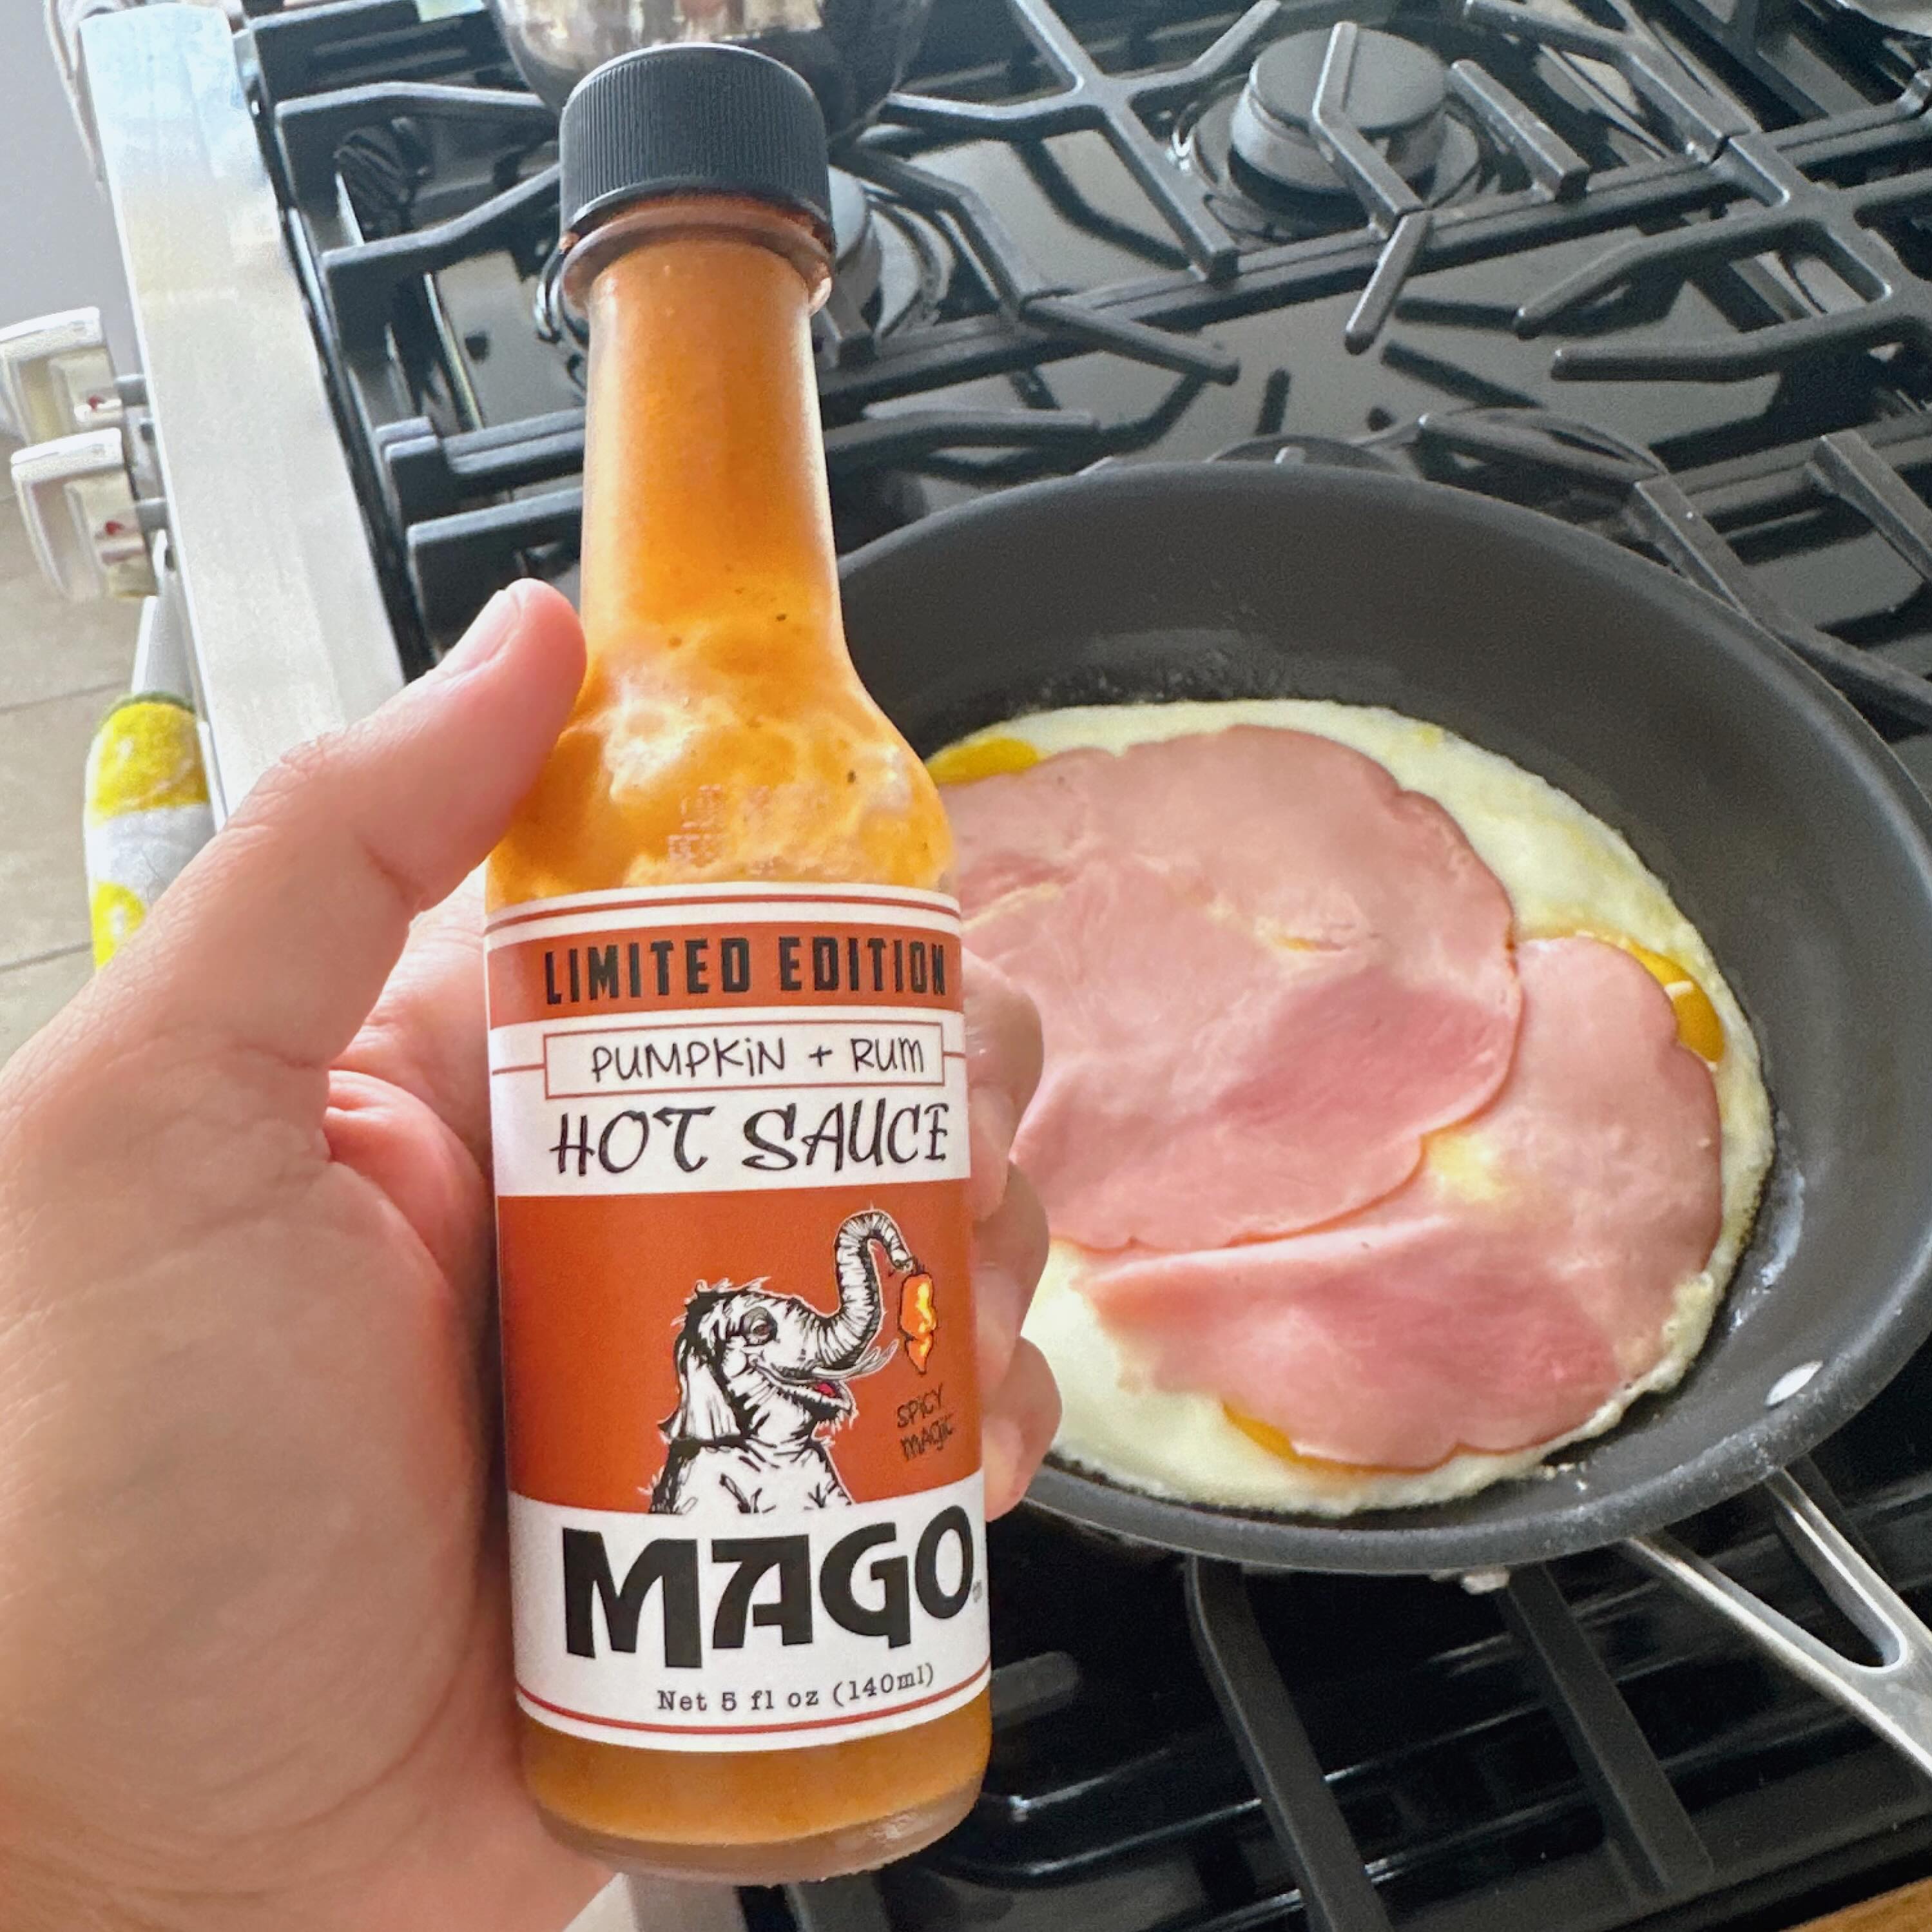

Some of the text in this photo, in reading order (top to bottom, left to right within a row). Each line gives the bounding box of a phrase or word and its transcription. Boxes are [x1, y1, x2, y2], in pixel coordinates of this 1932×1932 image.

[545, 936, 946, 1005] LIMITED EDITION
[809, 1046, 833, 1067] +
[549, 1098, 949, 1176] HOT SAUCE
[562, 1505, 973, 1668] MAGO
[657, 1663, 934, 1712] Net 5 fl oz (140ml)
